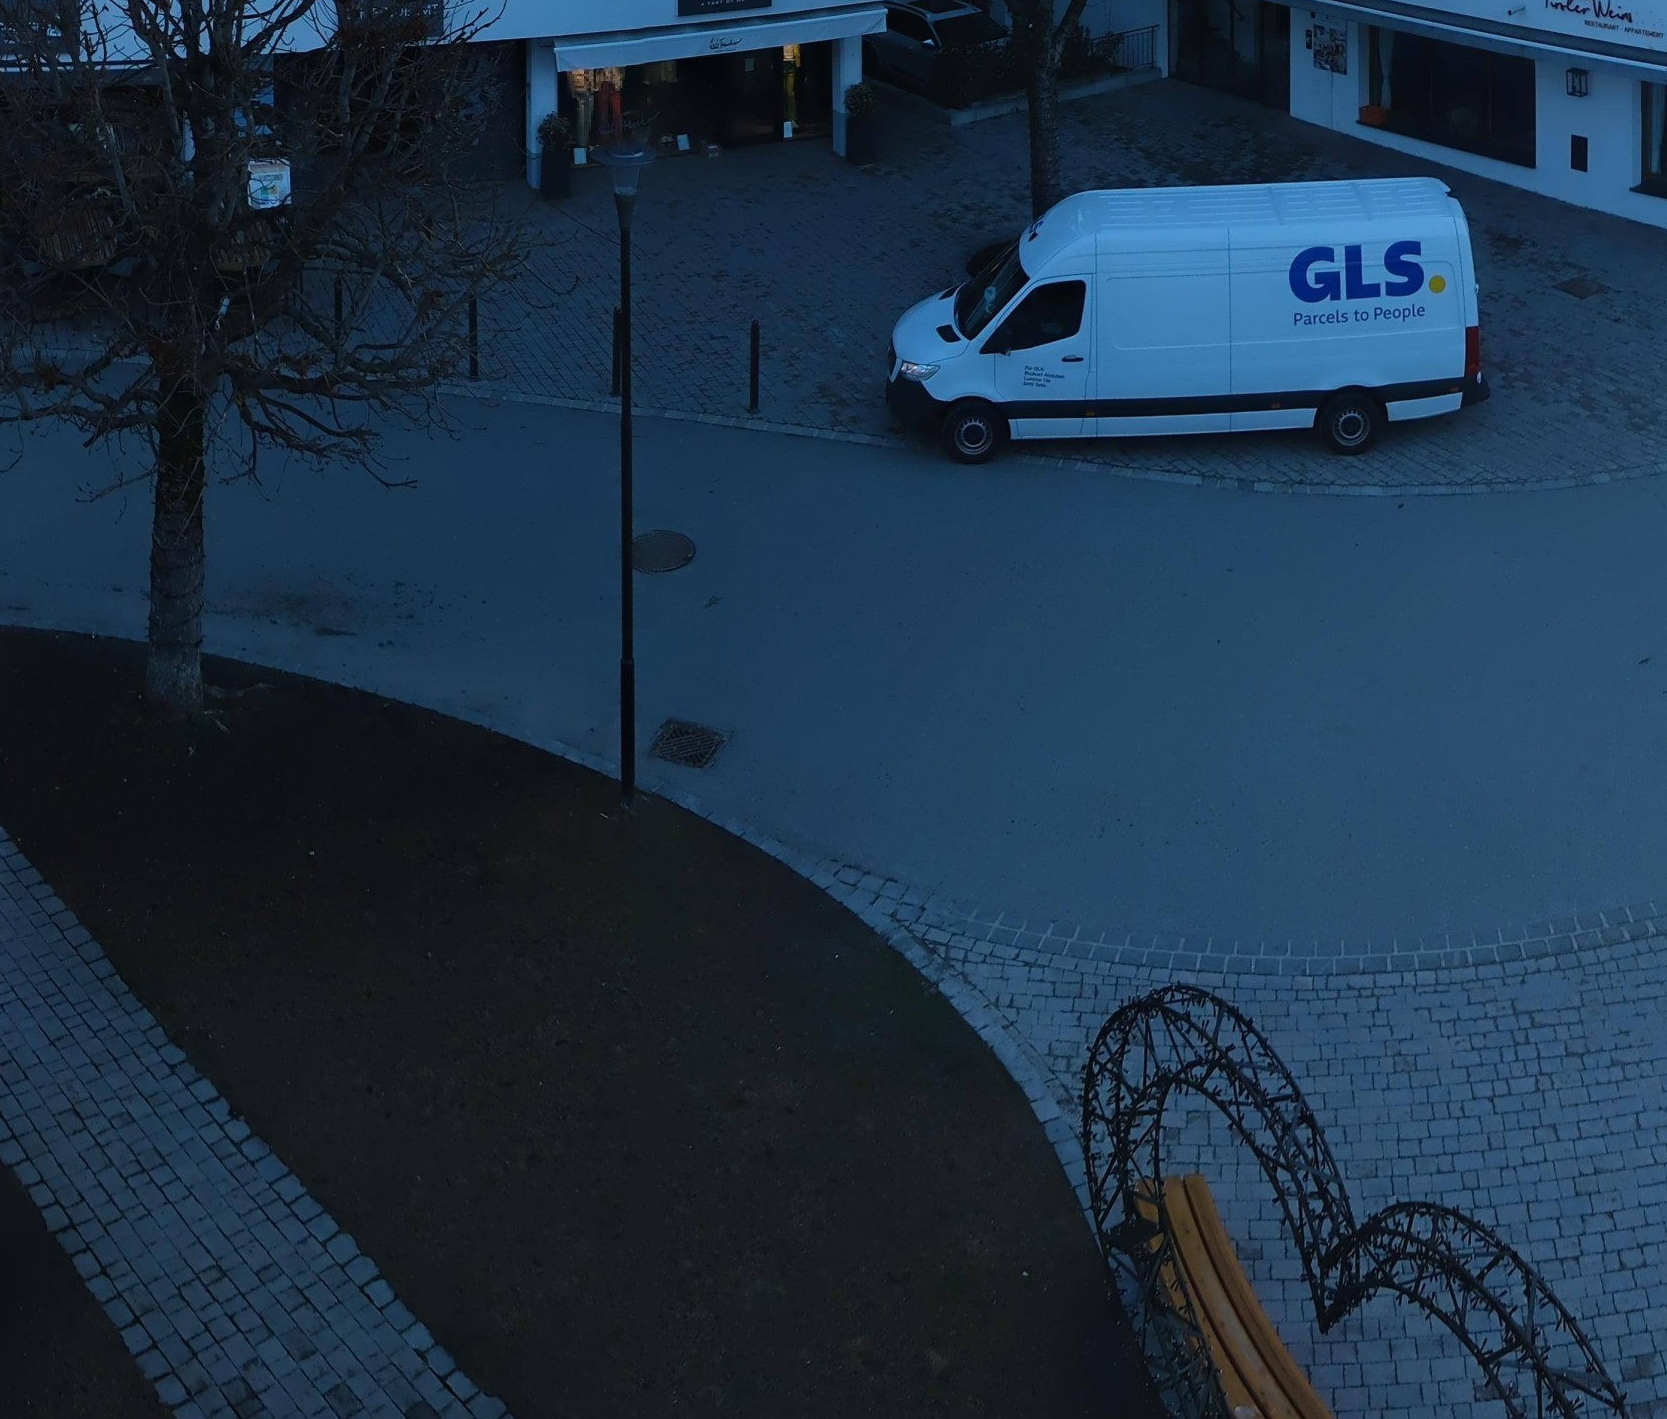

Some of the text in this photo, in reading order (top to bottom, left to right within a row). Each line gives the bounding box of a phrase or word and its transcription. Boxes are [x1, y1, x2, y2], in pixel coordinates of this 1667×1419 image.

[1293, 303, 1427, 326] Parcels to People
